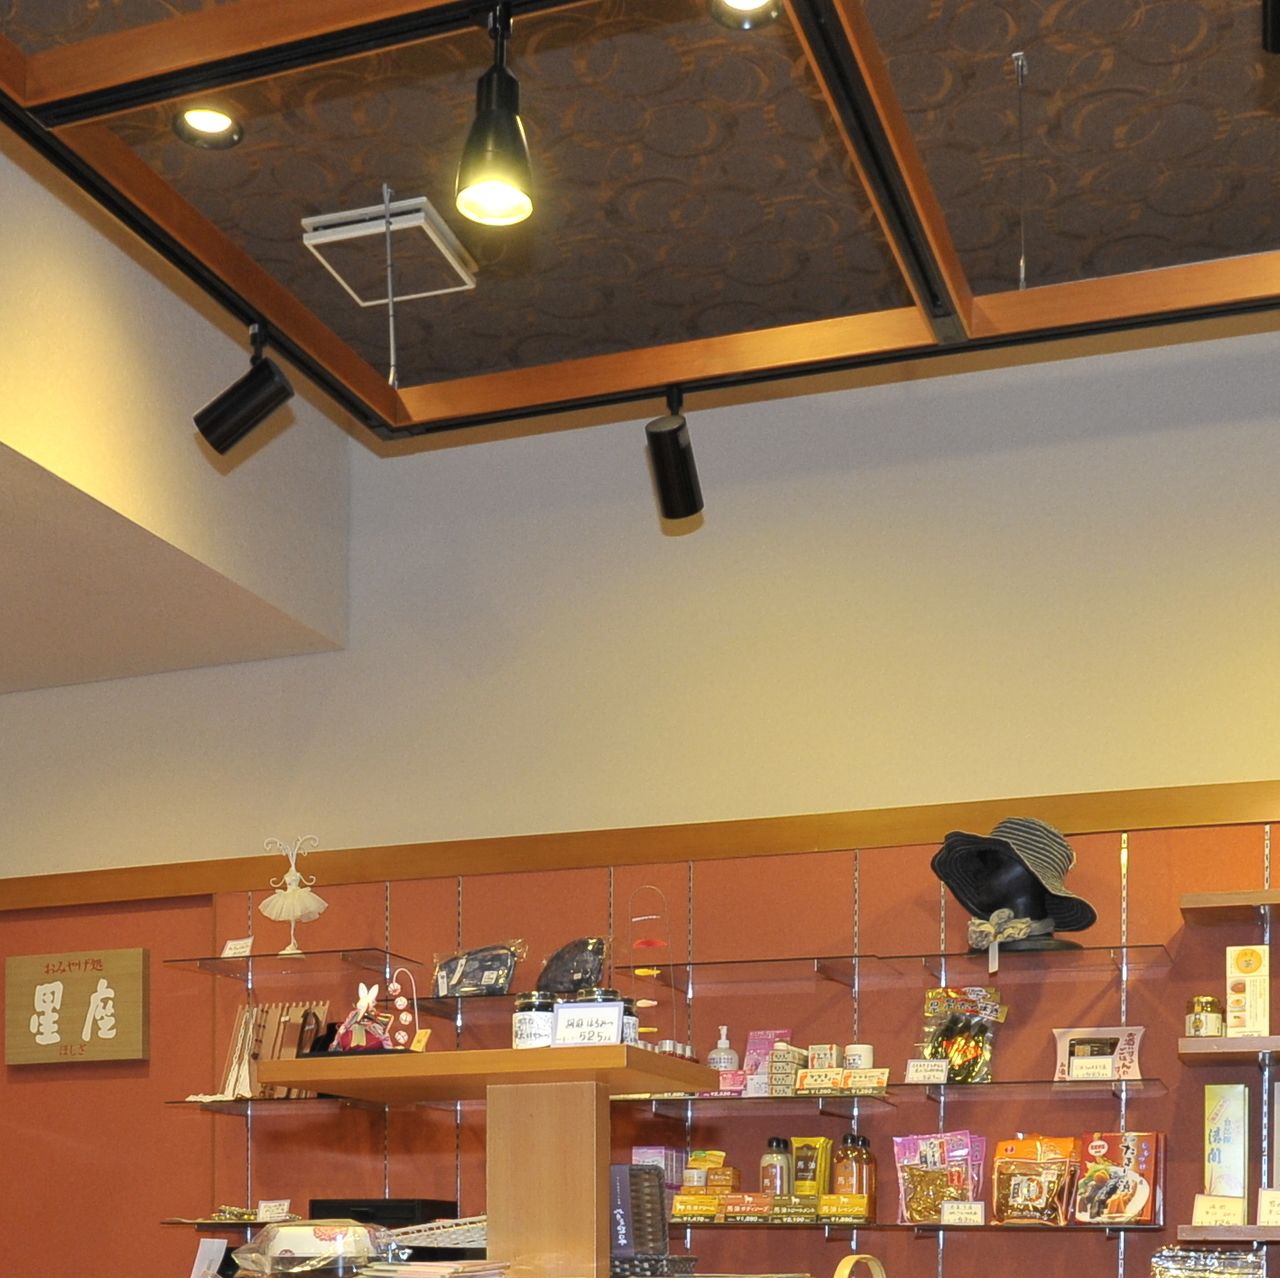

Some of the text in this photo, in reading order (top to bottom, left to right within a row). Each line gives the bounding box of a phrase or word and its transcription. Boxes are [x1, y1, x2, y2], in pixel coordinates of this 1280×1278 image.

[44, 958, 104, 975] おみやげ処
[58, 1043, 87, 1056] ほしざ
